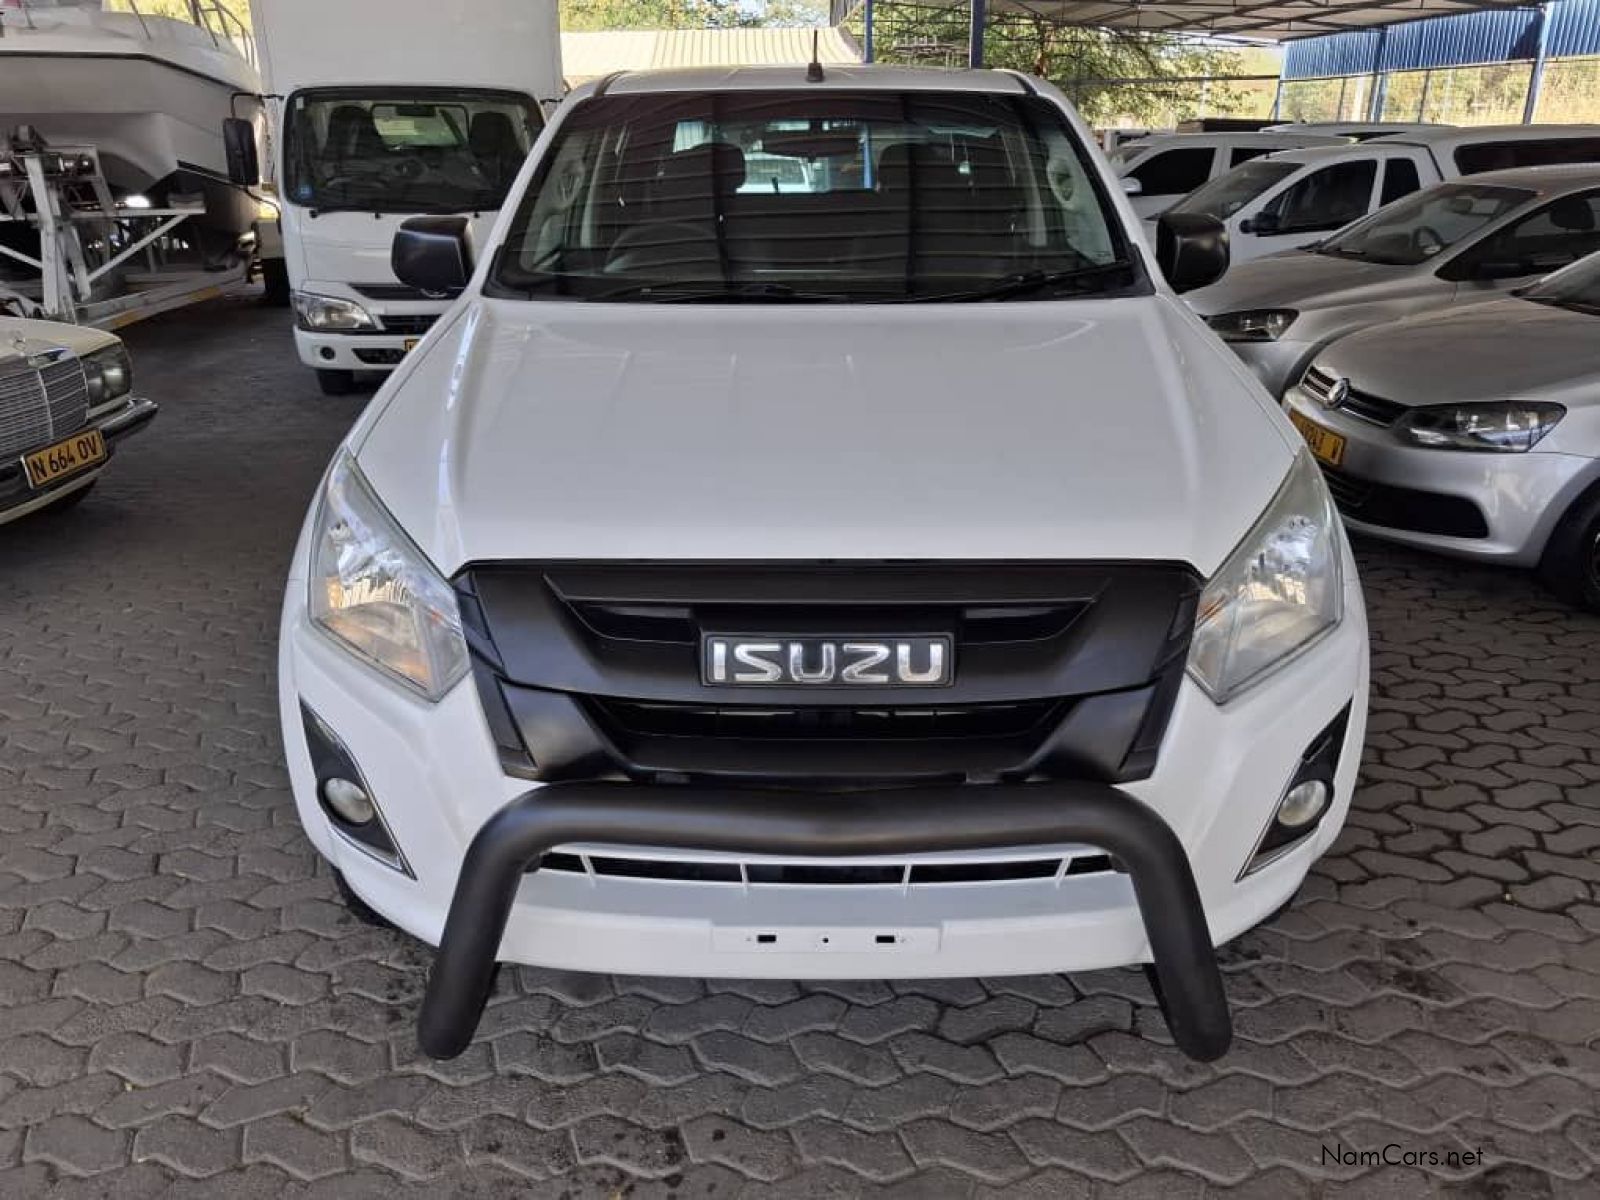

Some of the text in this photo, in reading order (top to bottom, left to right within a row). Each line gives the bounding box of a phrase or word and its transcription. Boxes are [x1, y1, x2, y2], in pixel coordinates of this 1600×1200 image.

[32, 456, 48, 479] N
[48, 444, 76, 473] 664
[713, 643, 943, 682] ISUZU
